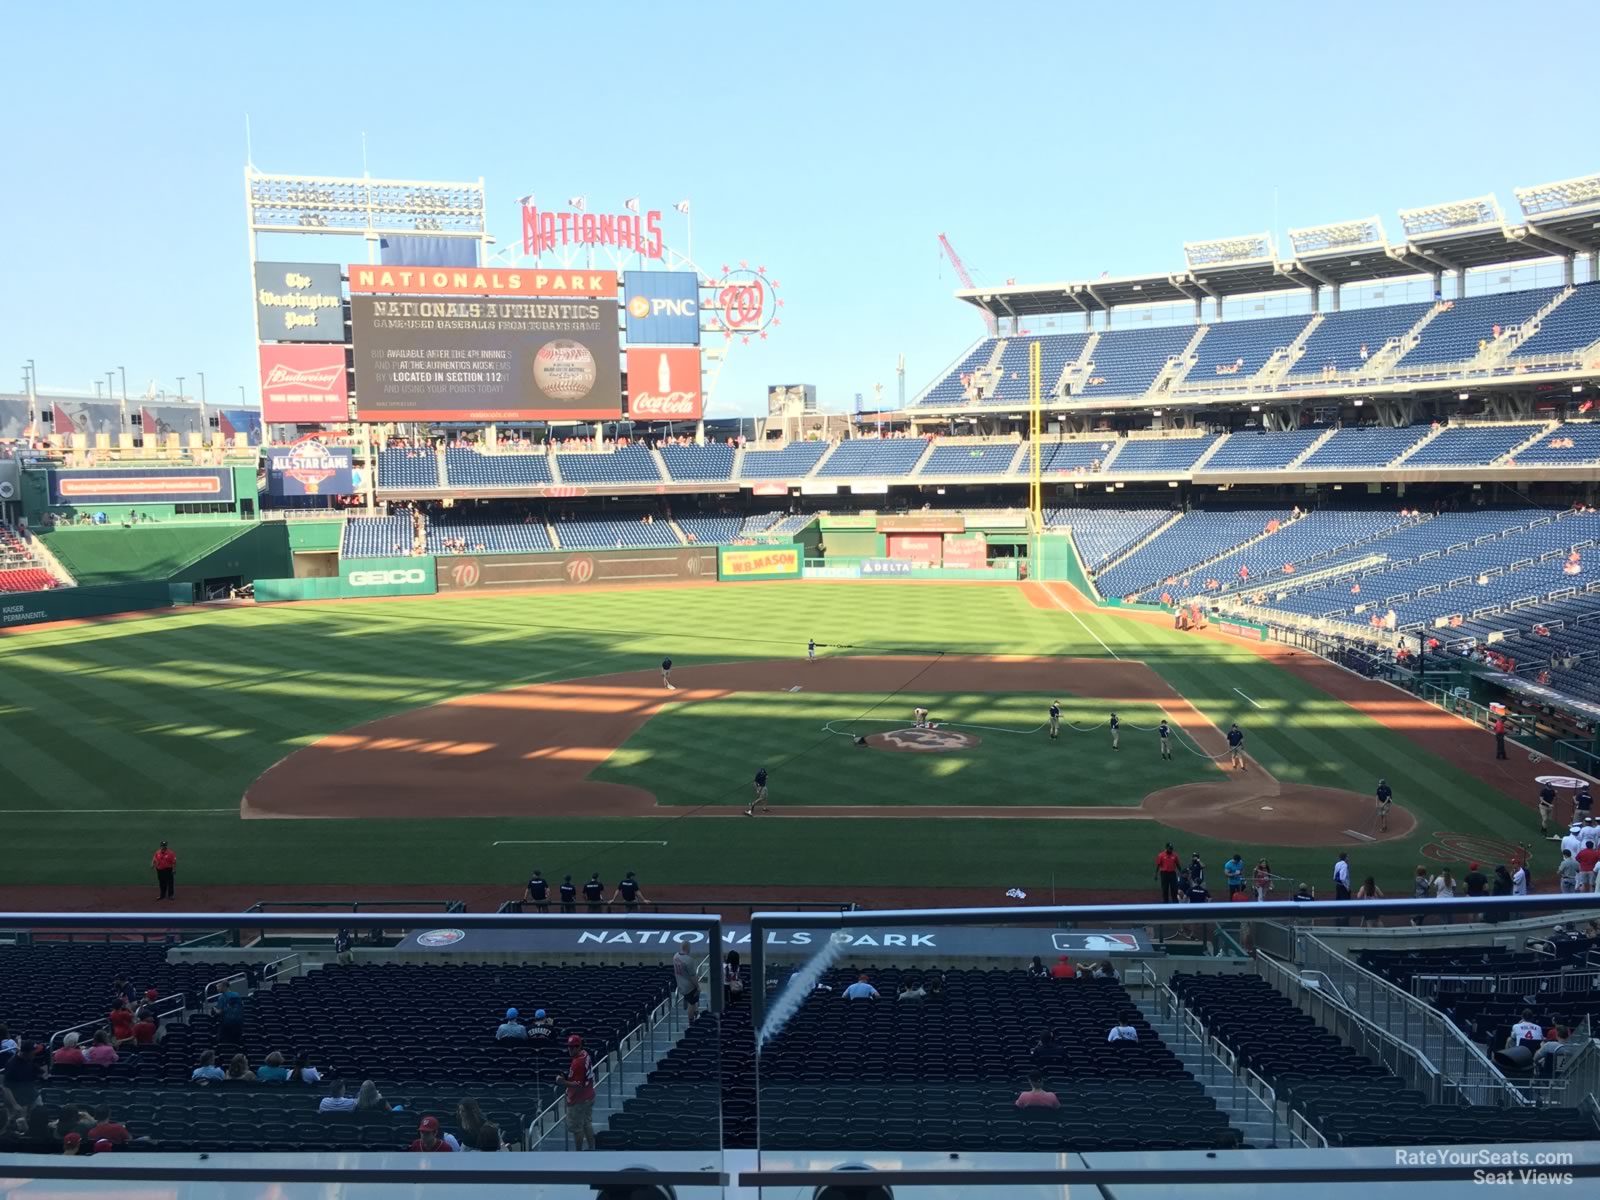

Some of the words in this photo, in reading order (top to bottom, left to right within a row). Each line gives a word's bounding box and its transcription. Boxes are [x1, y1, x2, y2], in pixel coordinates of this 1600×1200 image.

[522, 205, 663, 259] NATIONALS
[285, 272, 311, 289] The
[359, 271, 522, 289] NATIONALS
[535, 274, 603, 290] PARK
[259, 288, 340, 310] Washington
[651, 298, 696, 317] PNC
[373, 301, 481, 318] NATIONALS
[486, 303, 600, 320] AUTHENTICS
[284, 311, 317, 330] Post
[437, 320, 496, 330] BASEBALLS
[572, 321, 601, 331] GAME
[269, 369, 337, 383] Budweiser
[393, 372, 432, 382] LOCATED
[434, 372, 444, 382] IN
[446, 372, 483, 382] SECTION
[486, 372, 502, 382] 112
[633, 392, 697, 414] Coca-Cola
[321, 456, 349, 469] GAME
[874, 563, 910, 573] DELTA
[349, 569, 426, 587] GEICO
[3, 605, 24, 614] KAISER
